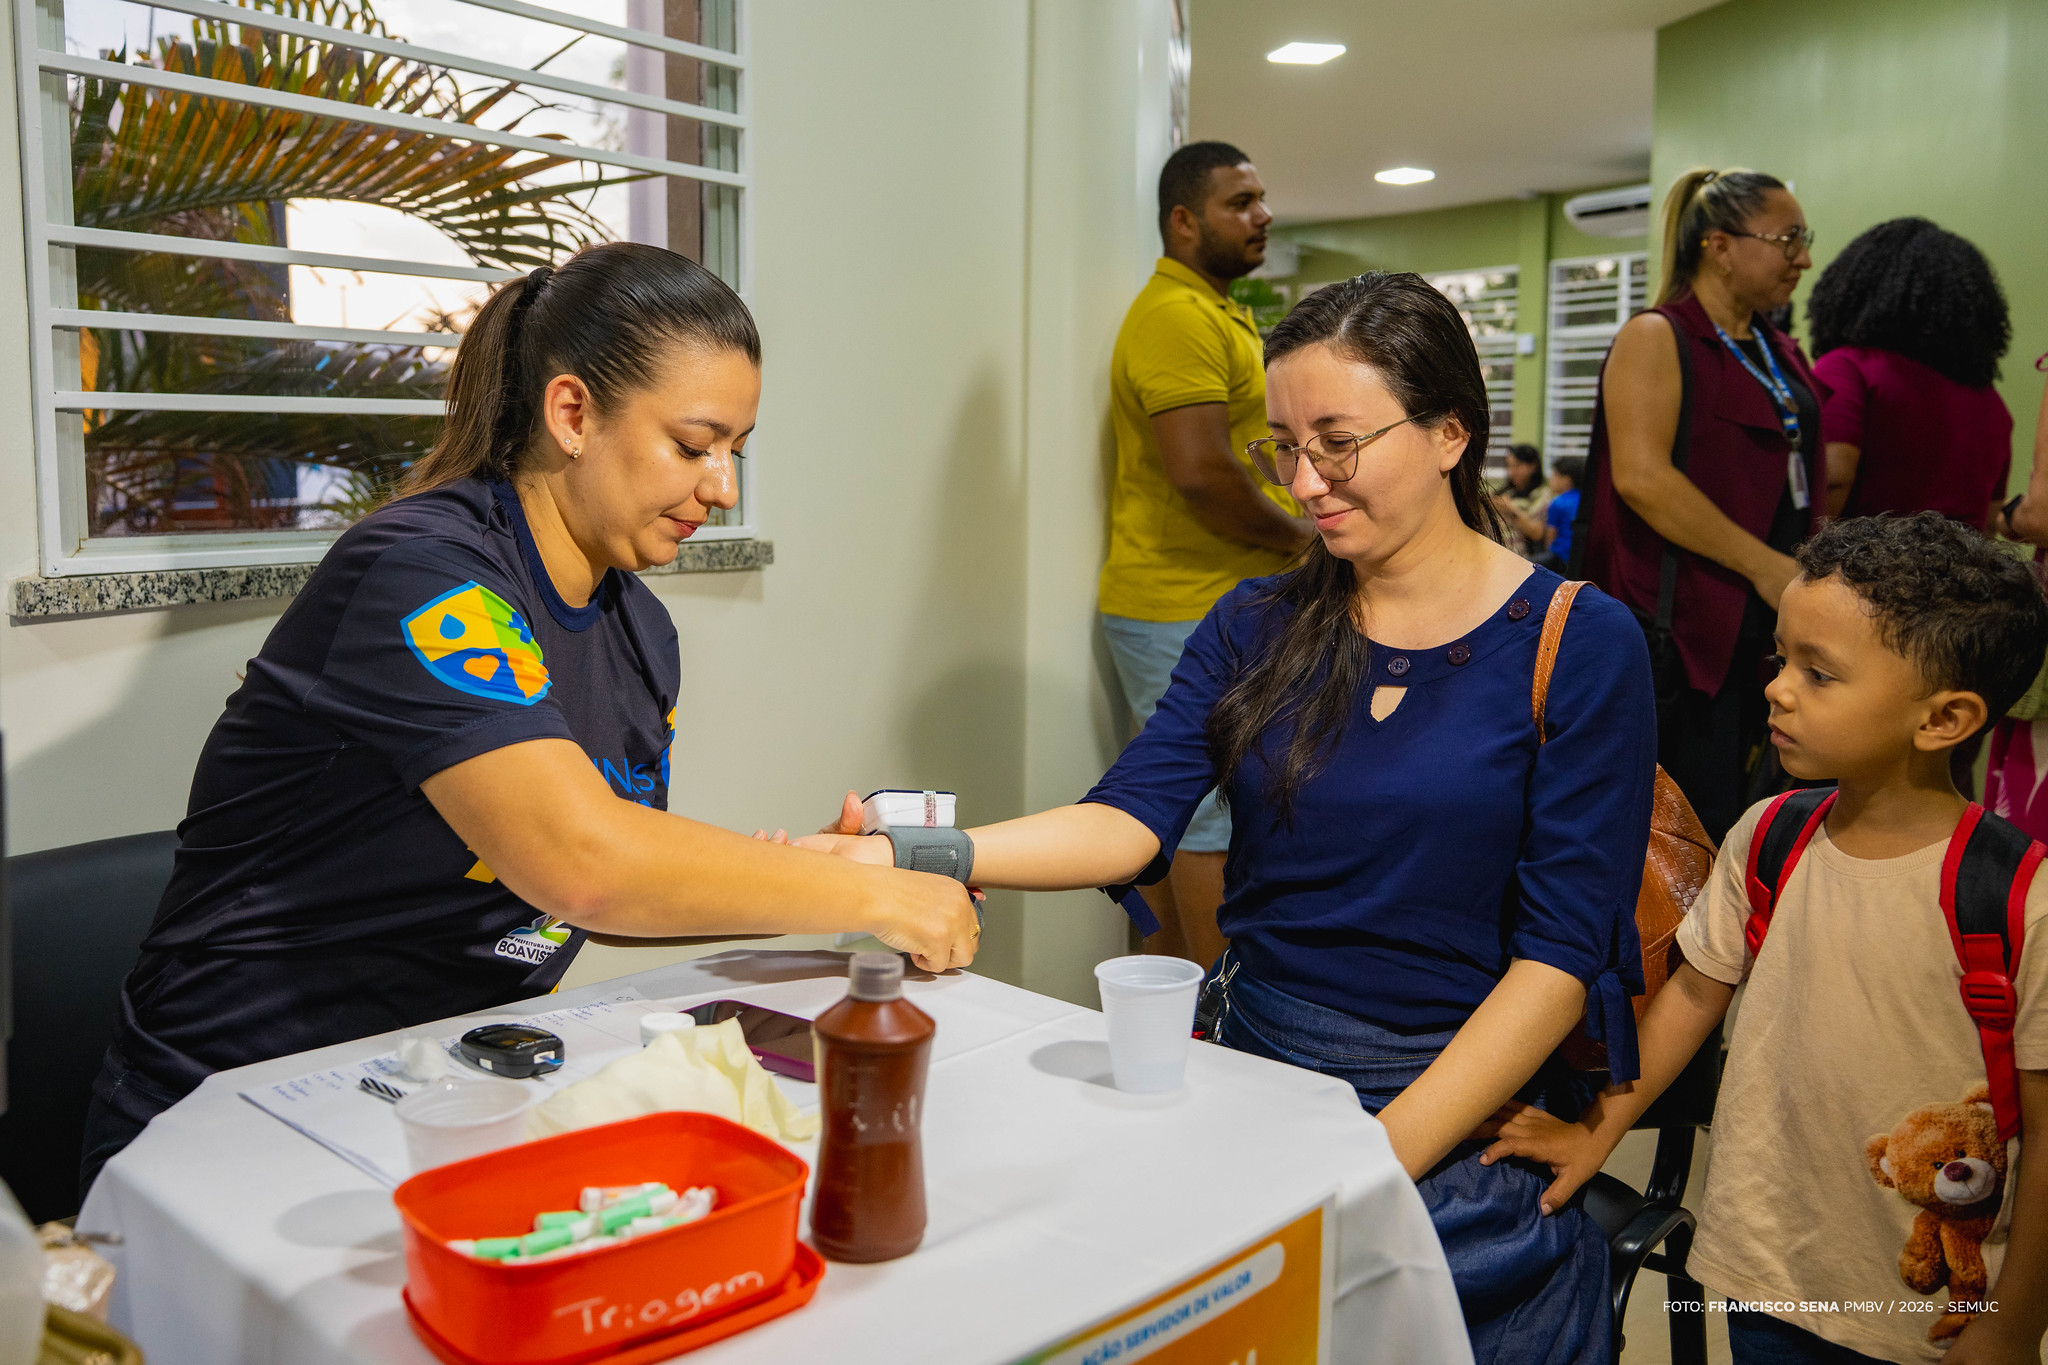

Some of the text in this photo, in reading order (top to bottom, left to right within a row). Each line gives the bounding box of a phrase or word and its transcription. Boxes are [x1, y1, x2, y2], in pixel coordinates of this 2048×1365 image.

[514, 938, 544, 949] PREFEITURA
[1125, 1303, 1191, 1351] SERVIDOR
[1193, 1293, 1210, 1315] DE
[1212, 1269, 1252, 1303] VALOR
